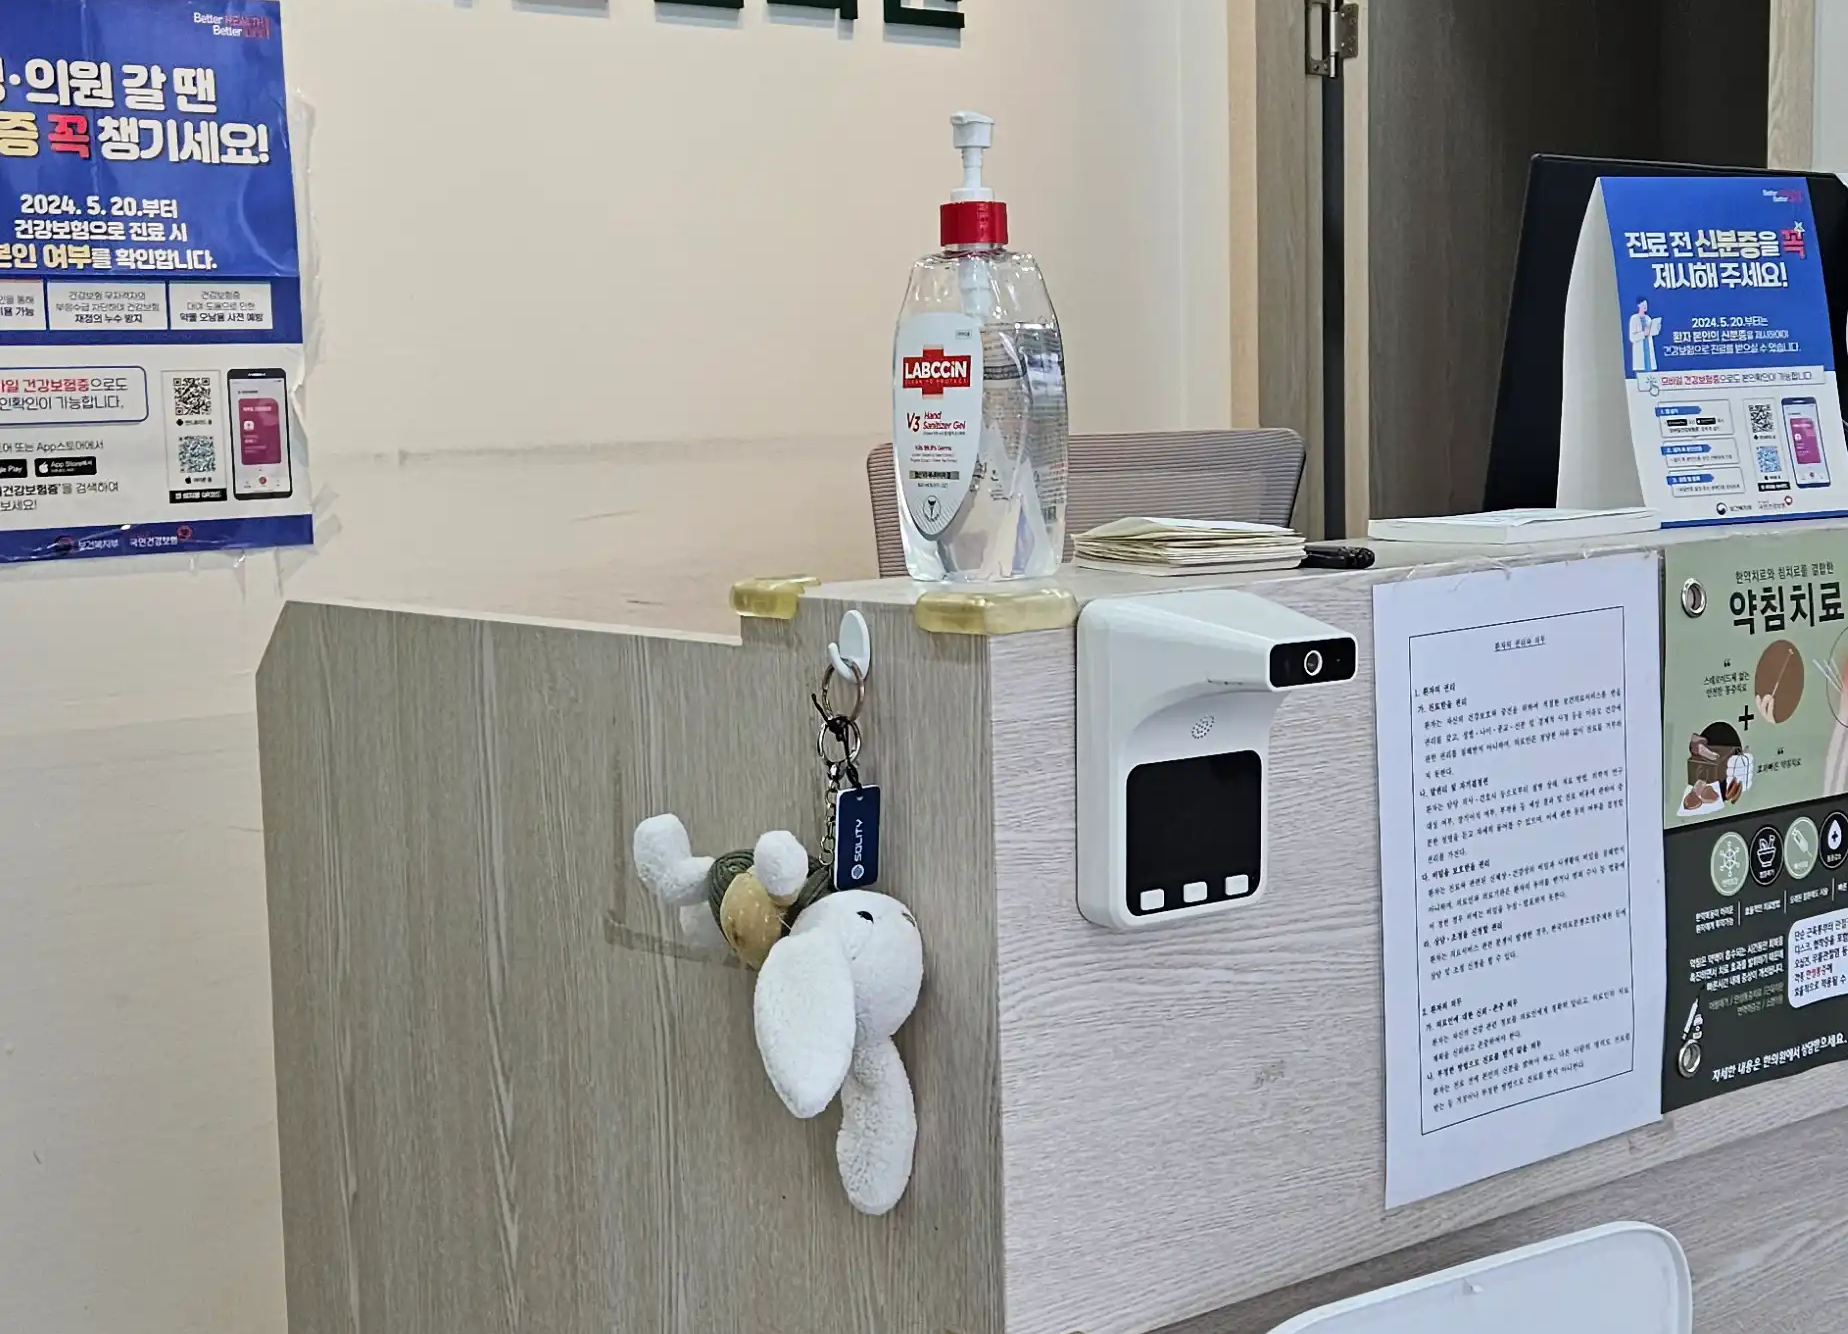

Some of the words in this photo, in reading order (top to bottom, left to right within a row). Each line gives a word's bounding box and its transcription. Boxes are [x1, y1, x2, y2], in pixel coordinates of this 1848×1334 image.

[193, 12, 223, 24] Better
[213, 25, 242, 37] Better
[0, 56, 115, 109] ·의원
[122, 64, 166, 111] 갈
[173, 67, 217, 113] 땐
[48, 114, 89, 159] 꼭
[97, 116, 270, 164] 챙기세요!
[20, 194, 81, 215] 2024.
[87, 195, 106, 216] 5.
[110, 196, 178, 218] 20.부터
[14, 219, 126, 241] 건강보험으로
[129, 222, 166, 241] 진료
[169, 223, 188, 243] 시
[1624, 231, 1669, 259] 진료
[1669, 231, 1694, 259] 전
[1695, 229, 1781, 259] 신분증을
[43, 244, 111, 270] 여부를
[115, 248, 218, 271] 확인합니다.
[1651, 262, 1719, 289] 제시해
[1719, 261, 1789, 289] 주세요!
[1691, 317, 1719, 328] 2024.
[1759, 344, 1767, 353] 수
[23, 377, 128, 393] 건강보험증으로도
[56, 394, 124, 410] 가능합니다.
[906, 412, 921, 433] V3
[924, 411, 942, 420] Hand
[923, 421, 952, 430] Sanitizer
[953, 420, 966, 430] Gel
[76, 481, 119, 494] 검색하여
[1730, 581, 1844, 635] 약침치료
[1712, 1064, 1736, 1082] 자세한
[1737, 1056, 1761, 1075] 내용은
[1763, 1045, 1800, 1069] 한의원에서
